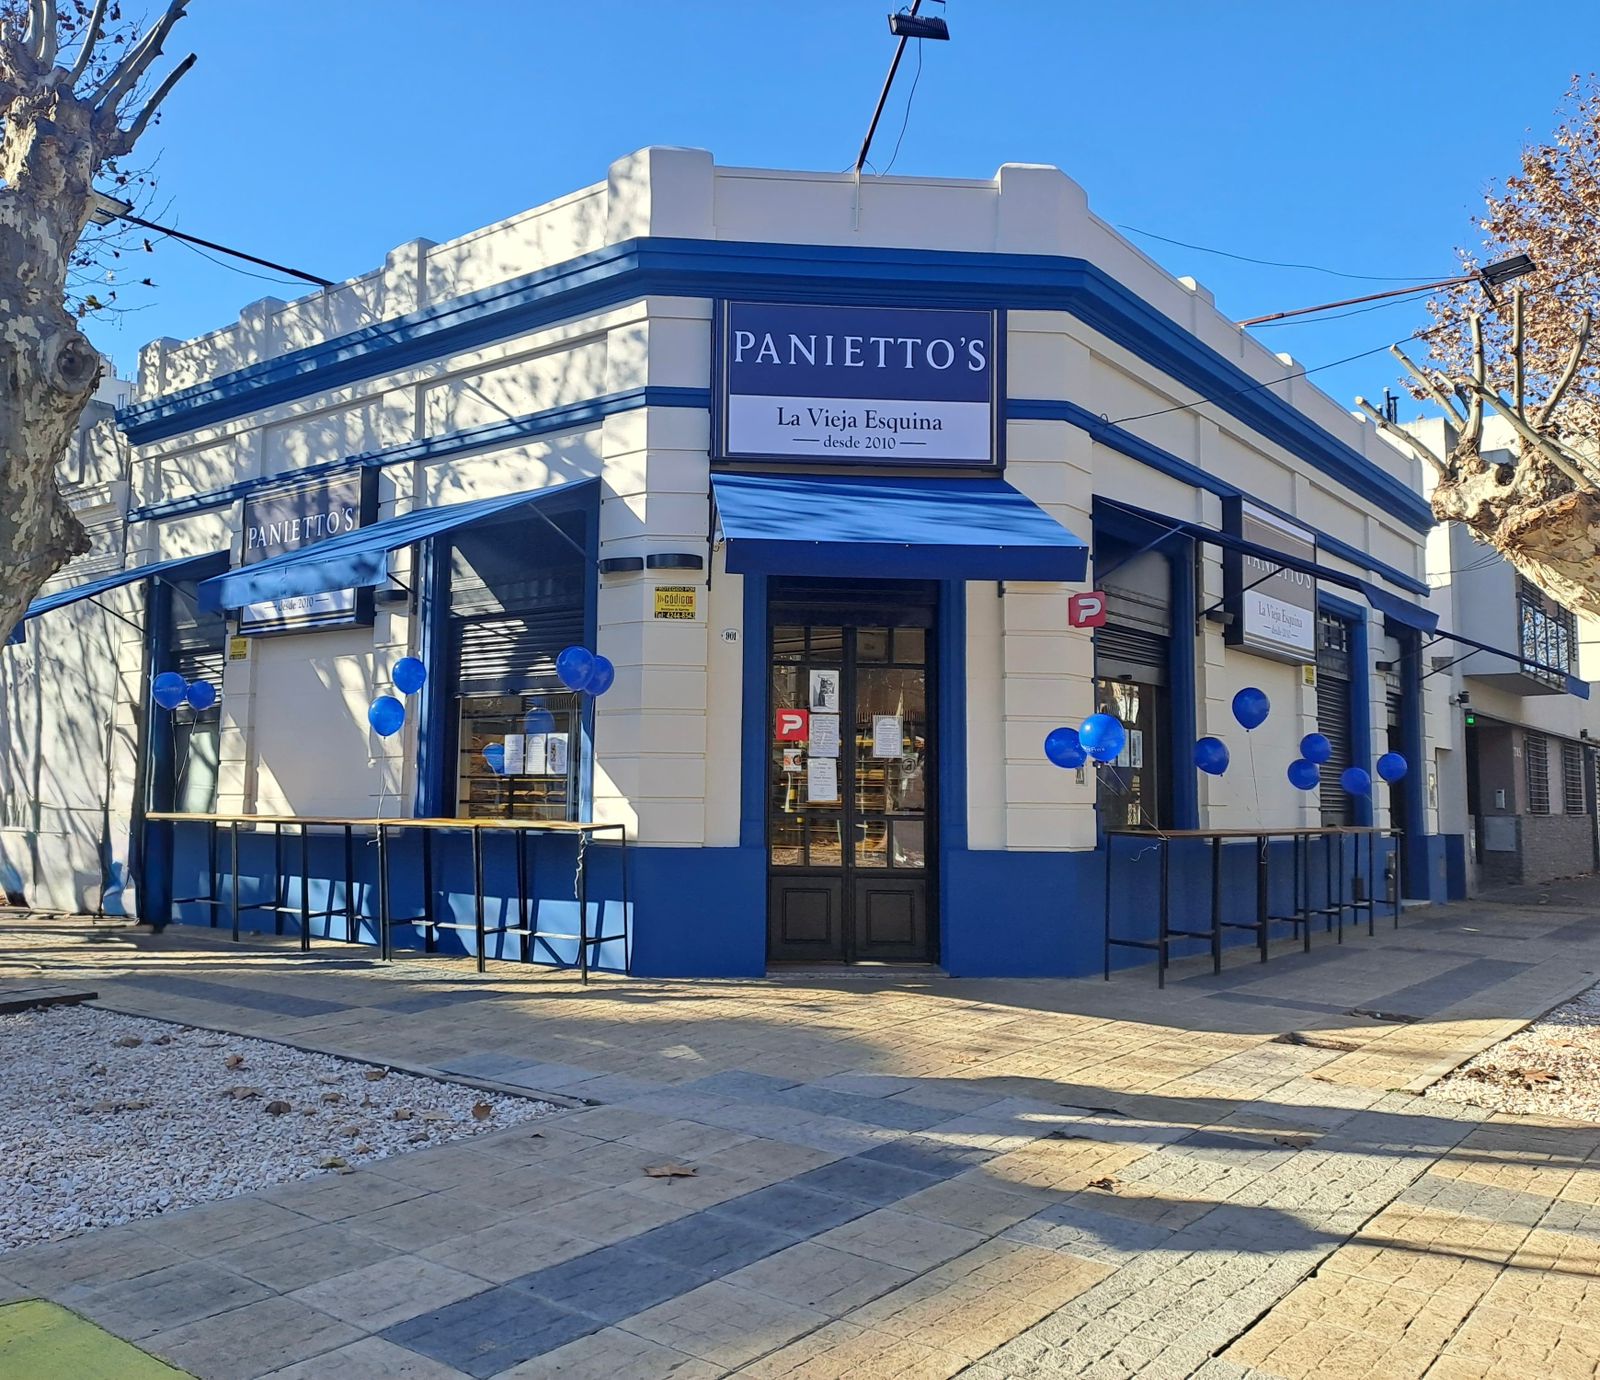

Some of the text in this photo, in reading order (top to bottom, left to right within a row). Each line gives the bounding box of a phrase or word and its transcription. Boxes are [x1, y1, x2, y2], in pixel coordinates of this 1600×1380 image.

[733, 330, 987, 372] PANIETTO'S
[776, 406, 944, 434] La Vieja Esquina
[823, 434, 897, 450] desde 2010
[247, 507, 355, 550] PANIETTO'S
[725, 631, 737, 641] 901
